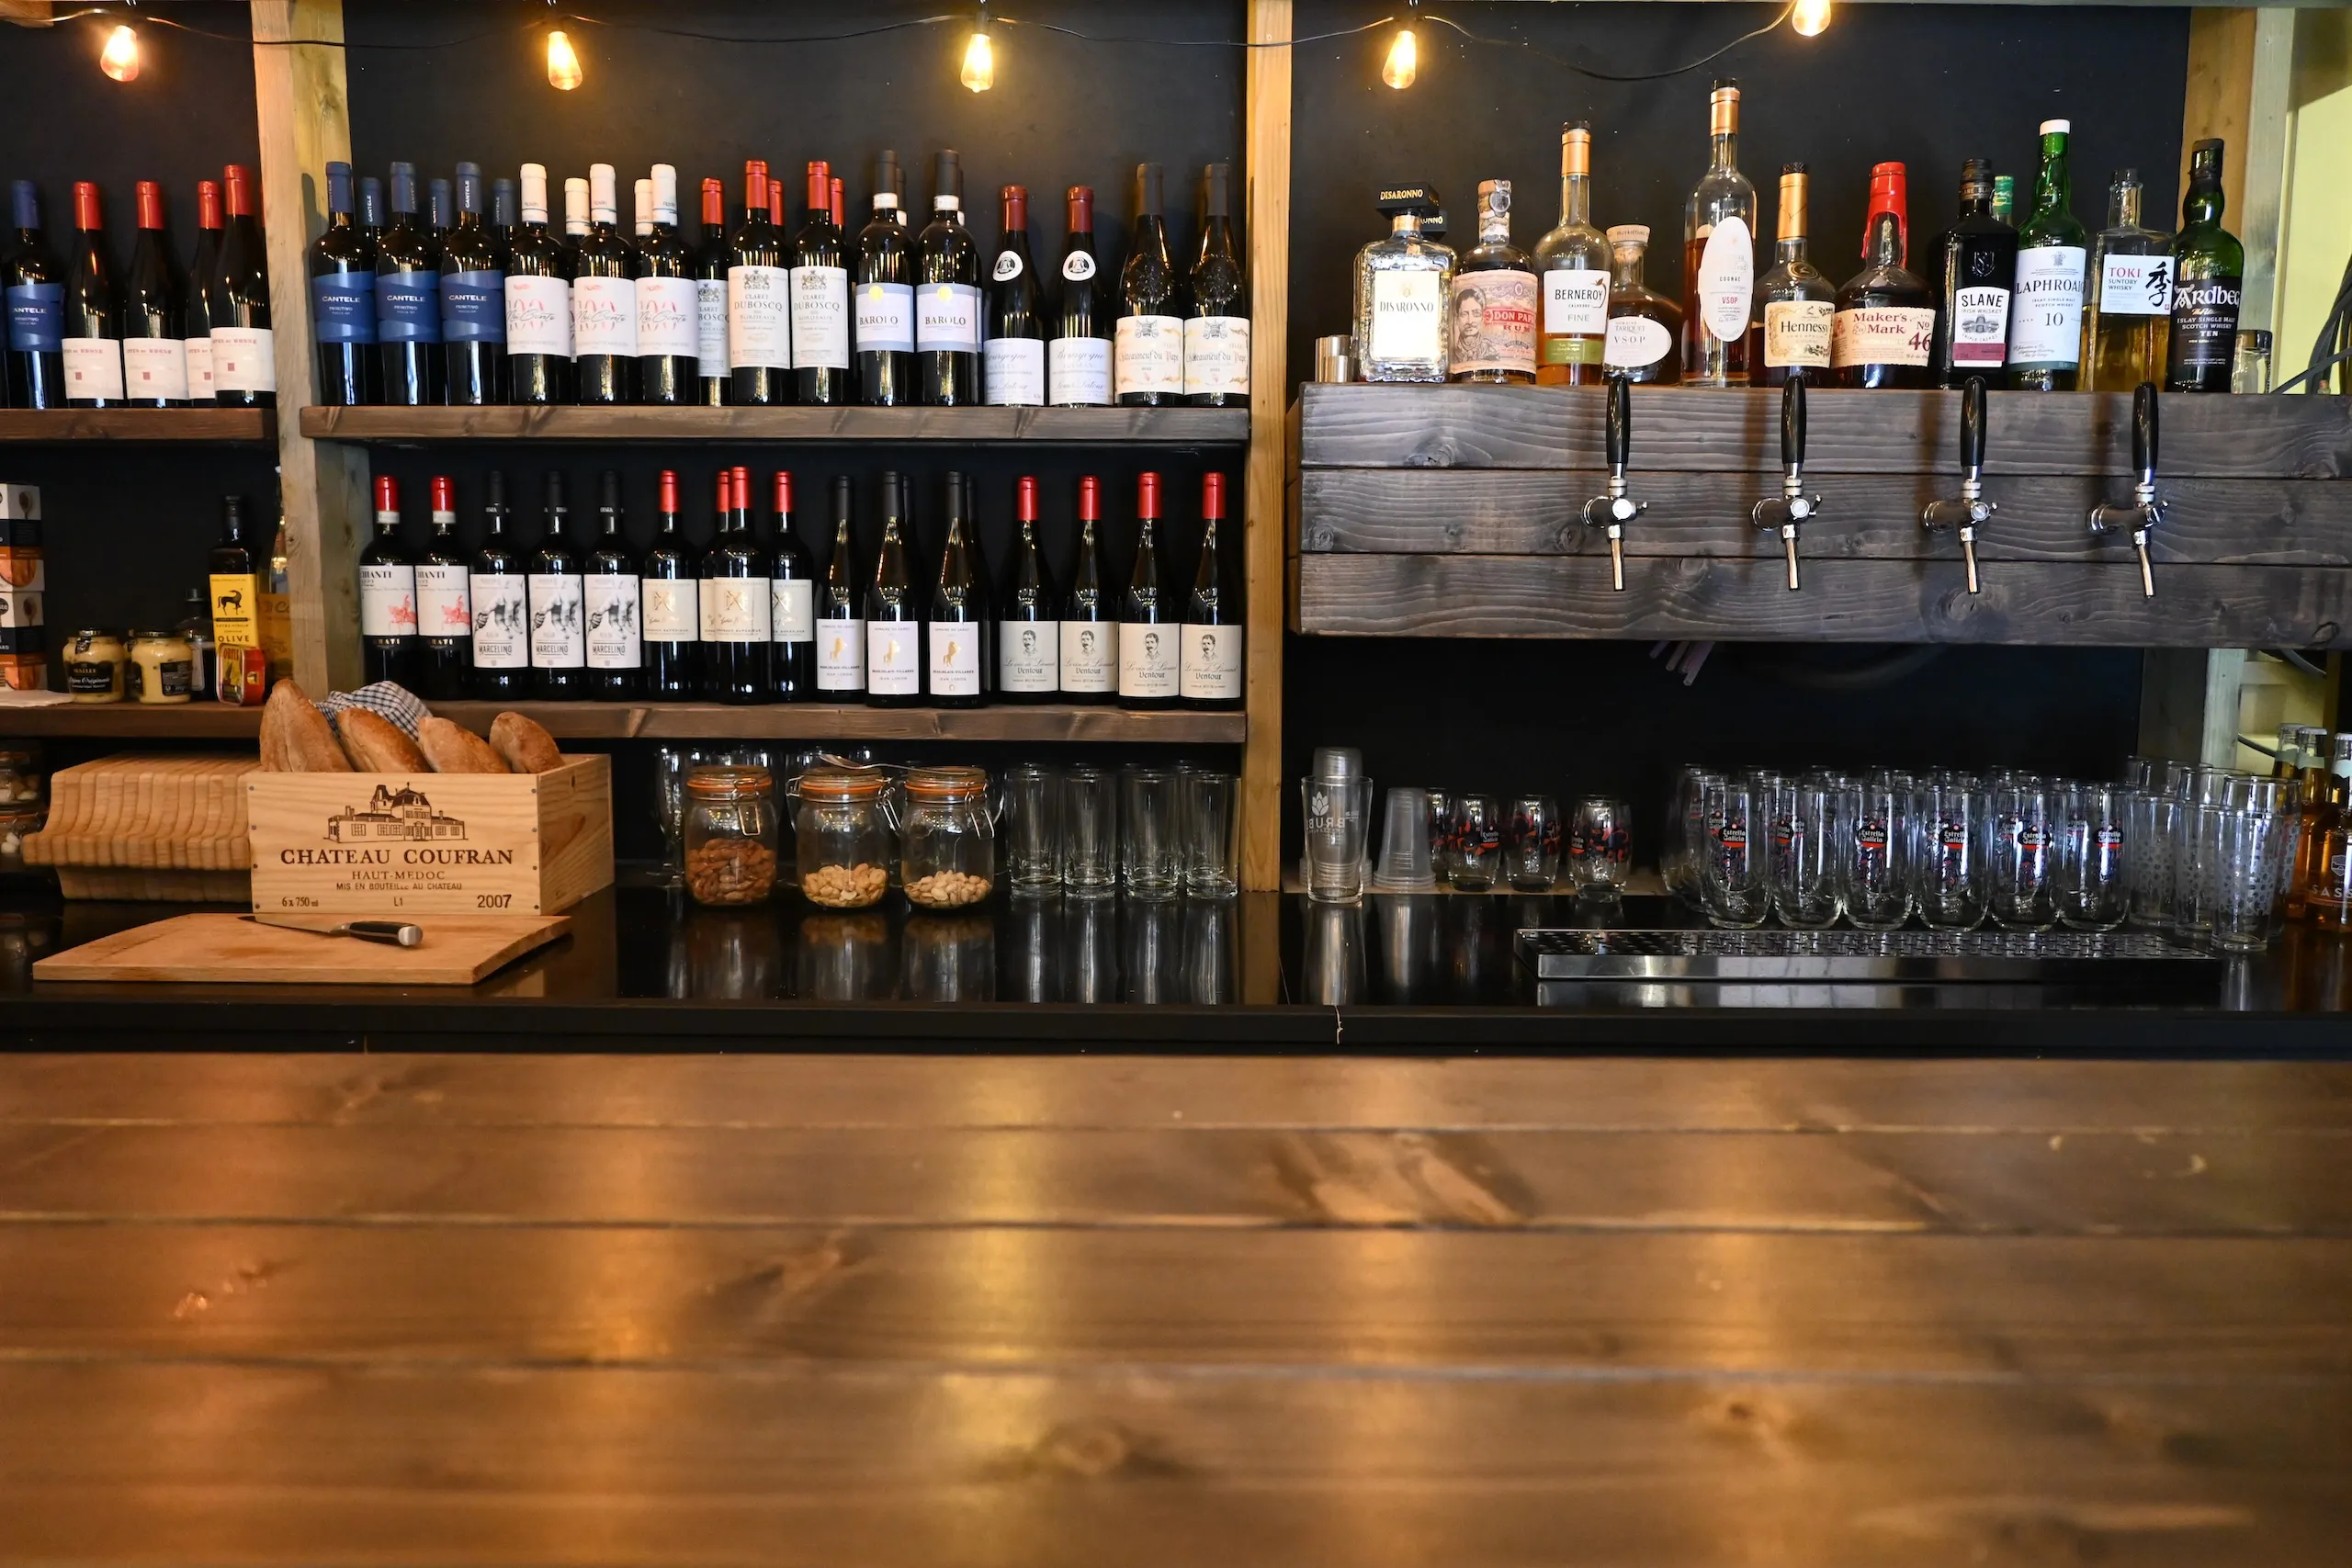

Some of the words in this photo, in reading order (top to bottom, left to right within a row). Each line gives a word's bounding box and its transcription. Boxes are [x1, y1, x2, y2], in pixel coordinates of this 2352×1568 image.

[1380, 189, 1423, 200] DISARONNO
[2109, 267, 2141, 277] TOKI
[1555, 288, 1603, 301] BERNEROY
[734, 300, 783, 311] DUBOSCQ
[794, 300, 840, 311] DUBOSCQ
[1961, 293, 2004, 308] SLANE
[1379, 301, 1433, 312] DISARONNO
[698, 313, 729, 322] BOSC
[859, 315, 899, 325] BAROLO
[924, 315, 967, 325] BAROLO
[1493, 311, 1515, 321] DON
[1517, 312, 1534, 322] PAP
[1853, 312, 1907, 322] Maker's
[2045, 311, 2064, 326] 10
[1781, 321, 1828, 335] Hennessy
[1867, 324, 1907, 334] Mark
[1908, 332, 1931, 352] 46
[479, 645, 513, 656] MARCELINO
[536, 645, 569, 656] MARCELINO
[592, 645, 626, 656] MARCELINO
[1723, 829, 1746, 837] Estrella
[1860, 829, 1884, 838] Estrella
[2022, 831, 2046, 840] Estrella
[280, 849, 390, 864] CHATEAU
[403, 849, 514, 864] COUFRAN
[352, 870, 446, 880] HAUT-MEDOC
[336, 882, 351, 890] MIS
[355, 882, 366, 890] EN
[413, 882, 424, 890] AU
[427, 882, 462, 890] CHATEAU
[296, 897, 311, 907] 750
[477, 894, 513, 908] 2007
